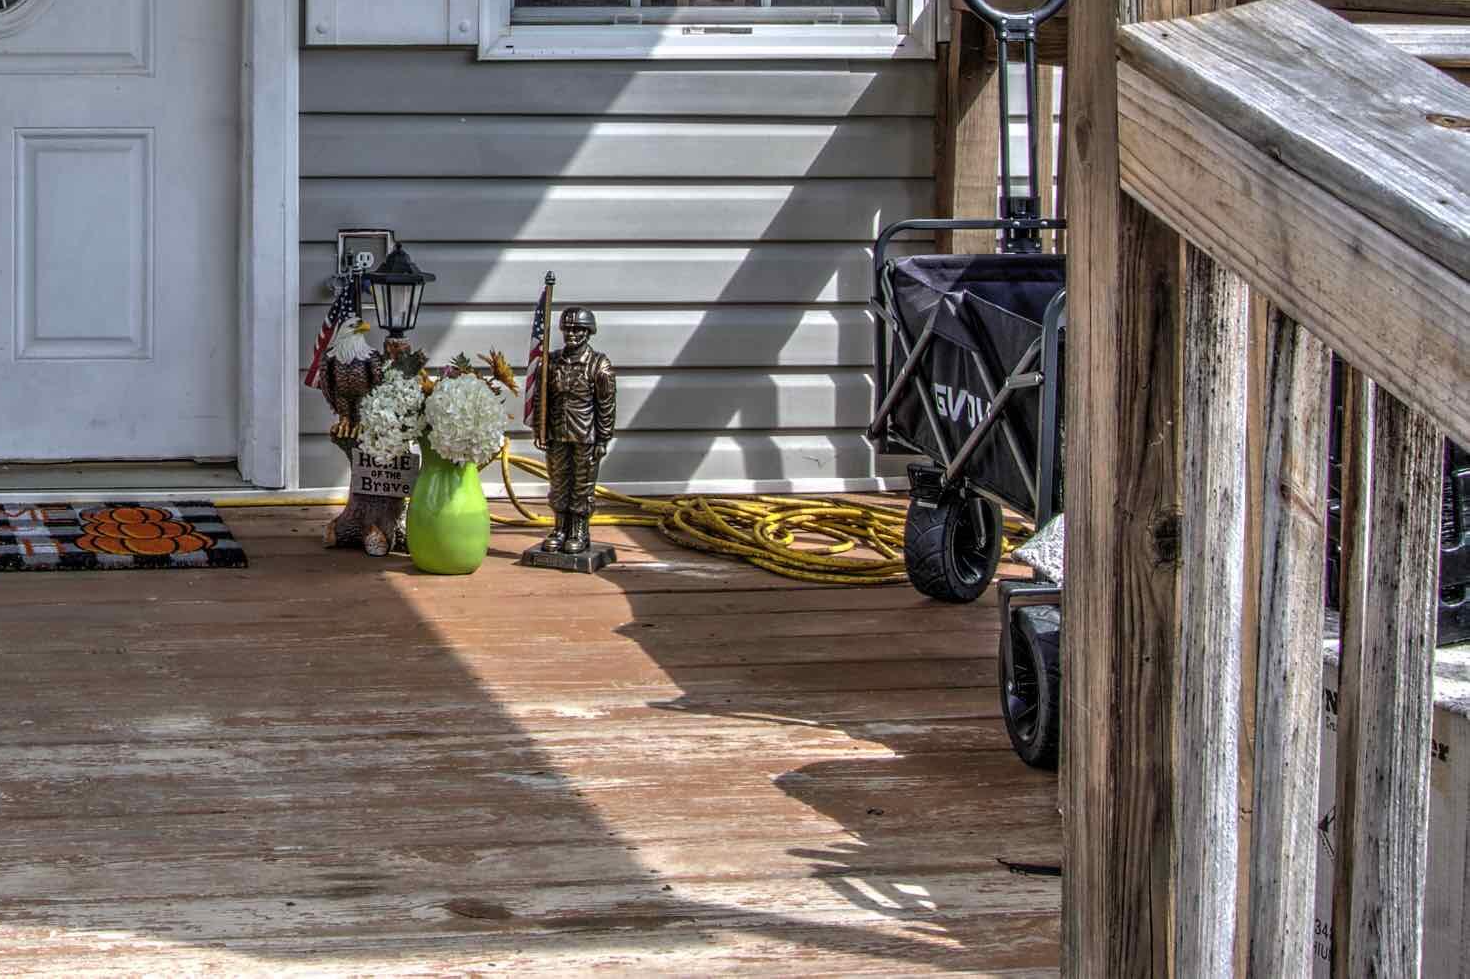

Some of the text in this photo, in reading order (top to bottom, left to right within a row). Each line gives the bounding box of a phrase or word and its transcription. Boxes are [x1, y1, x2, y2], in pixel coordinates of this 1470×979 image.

[371, 470, 402, 480] OF THE
[361, 477, 410, 494] Brave
